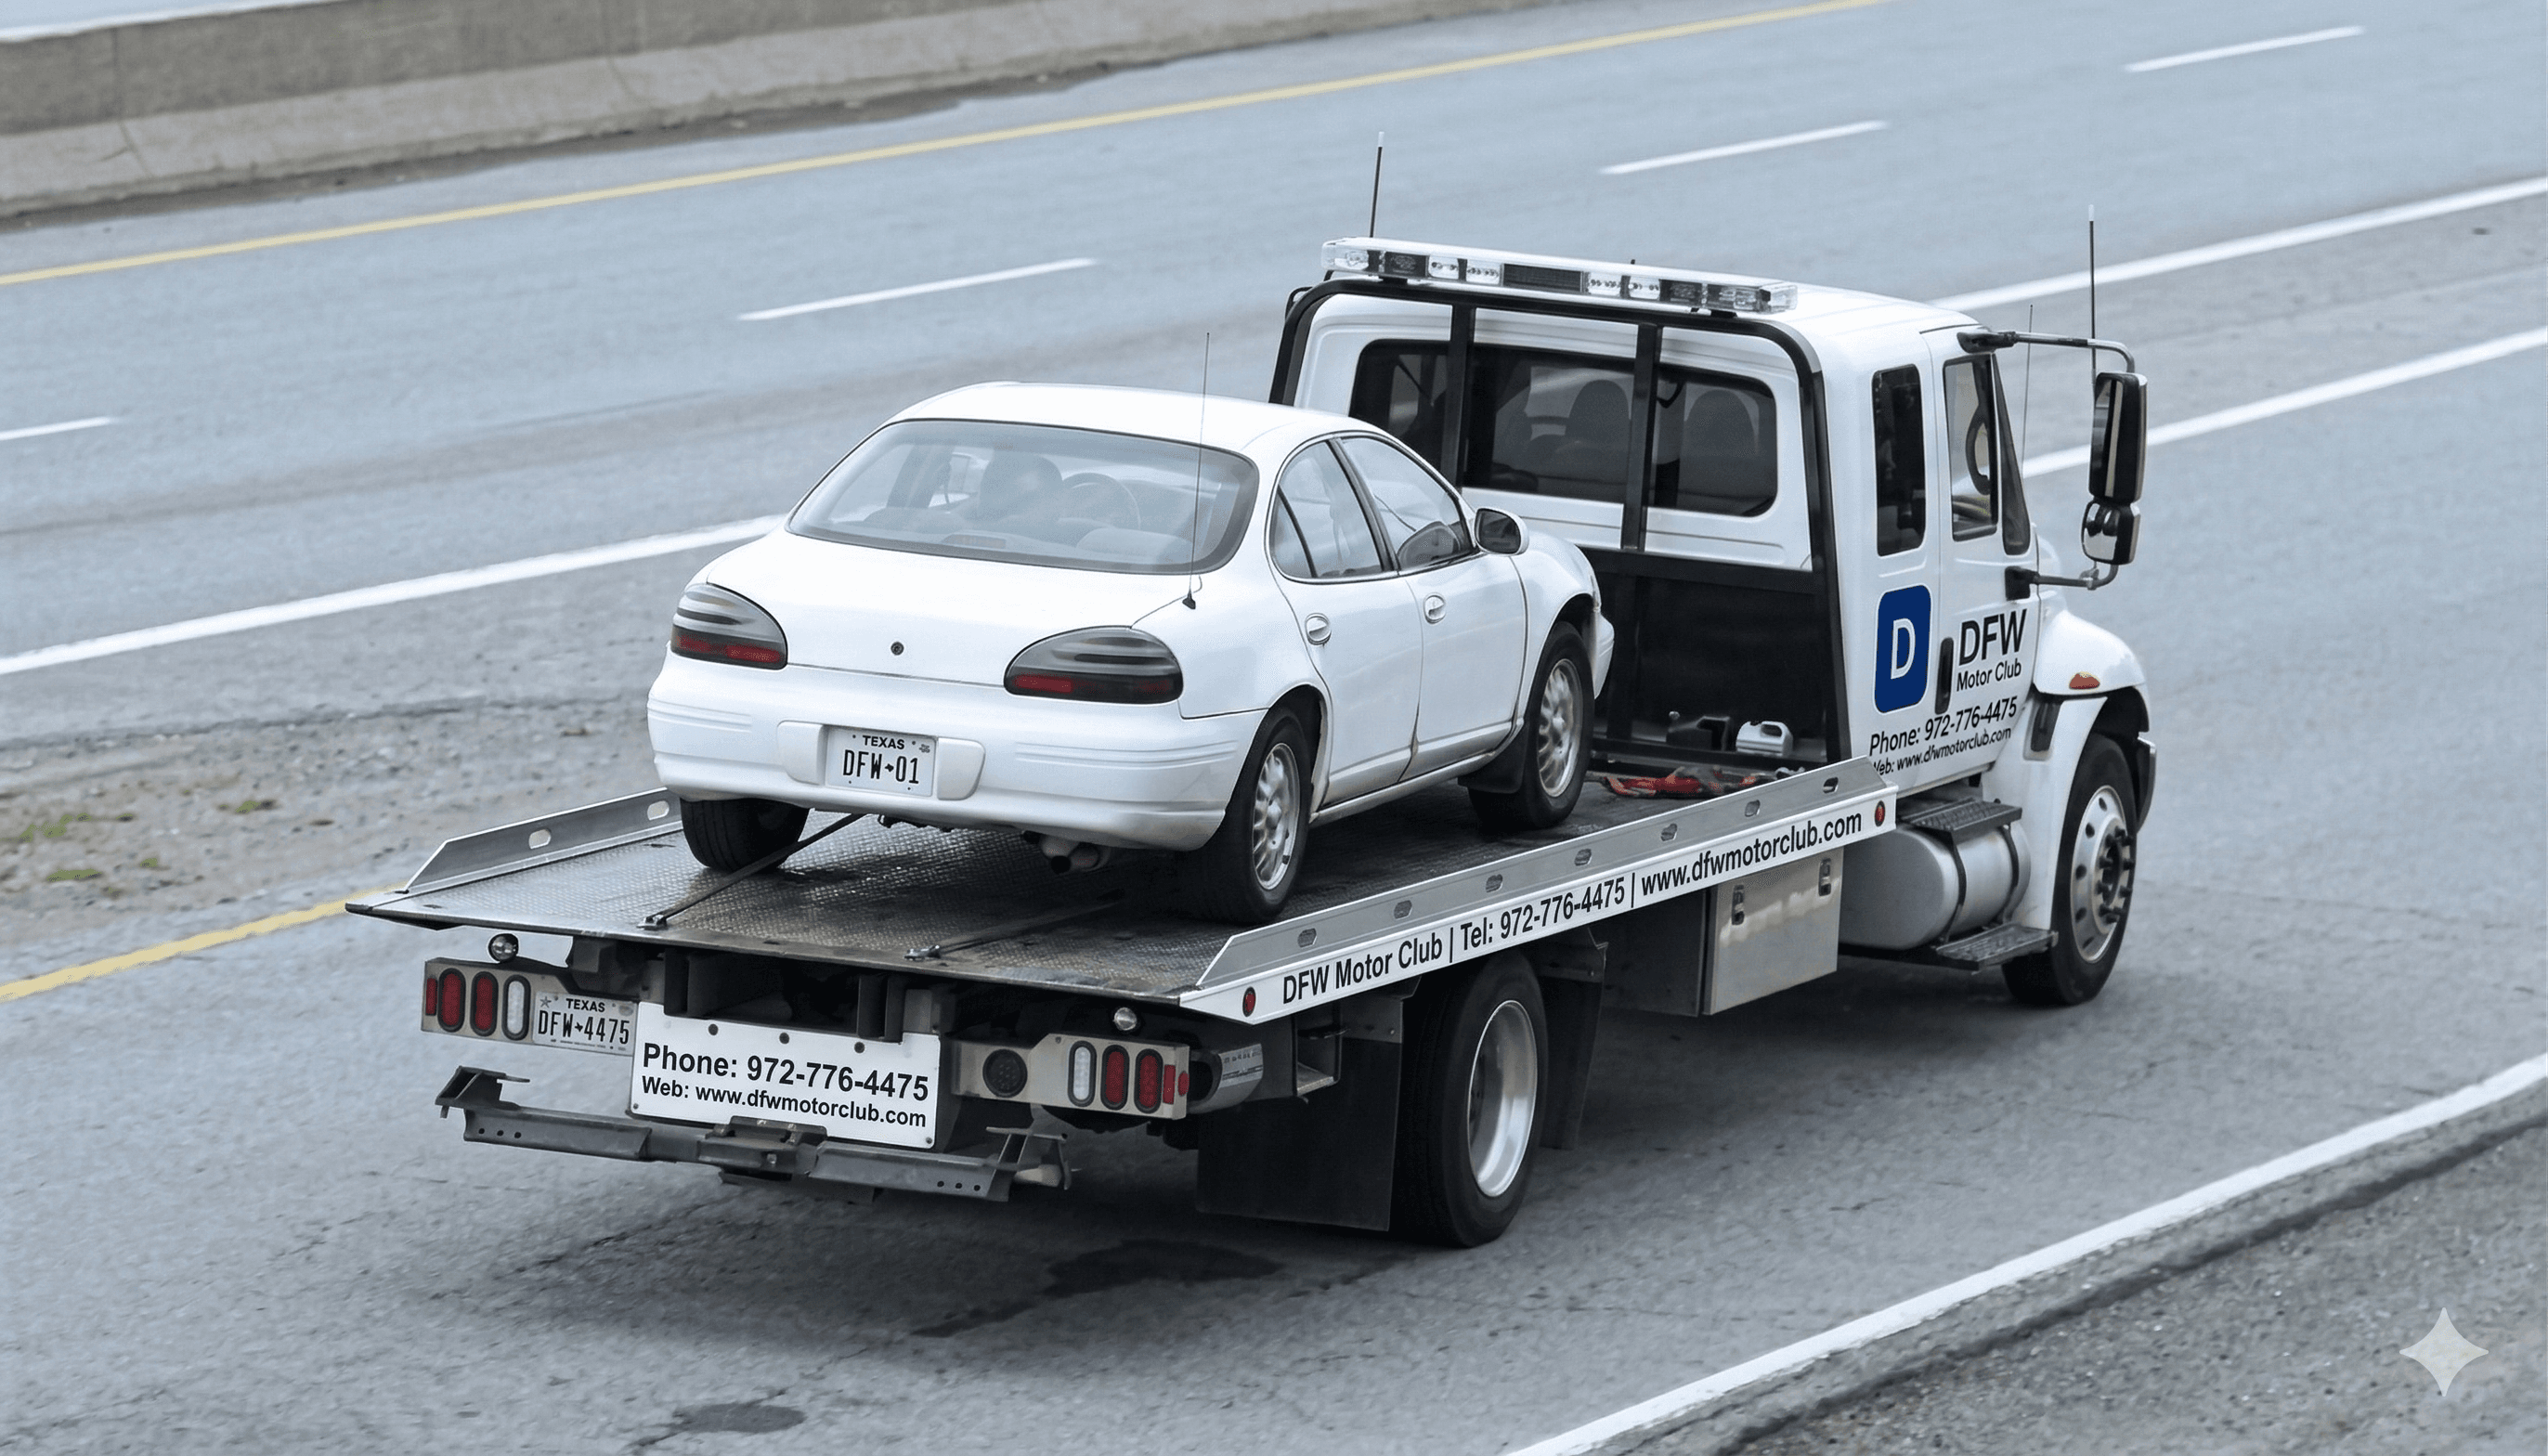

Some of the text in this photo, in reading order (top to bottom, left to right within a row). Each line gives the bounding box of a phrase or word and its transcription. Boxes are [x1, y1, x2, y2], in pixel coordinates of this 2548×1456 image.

[1959, 608, 2027, 666] DFW
[1956, 657, 2022, 692] Motor Club
[863, 734, 905, 750] TEXAS
[1869, 696, 2018, 756] Phone: 972-776-4475
[1897, 727, 2011, 771] www.dfwmotorclub.com
[1283, 966, 1330, 1004] DFW
[1335, 953, 1393, 989] Motor
[1398, 933, 1443, 968] Club
[1460, 917, 1493, 951] Tel:
[1501, 878, 1625, 939] 972-776-4475
[1641, 812, 1862, 896] www.dfwmotorclub.com
[566, 998, 605, 1012] TEXAS
[643, 1042, 929, 1102] Phone: 972-776-4475
[642, 1075, 927, 1128] Web: www.dfwmotorclub.com
